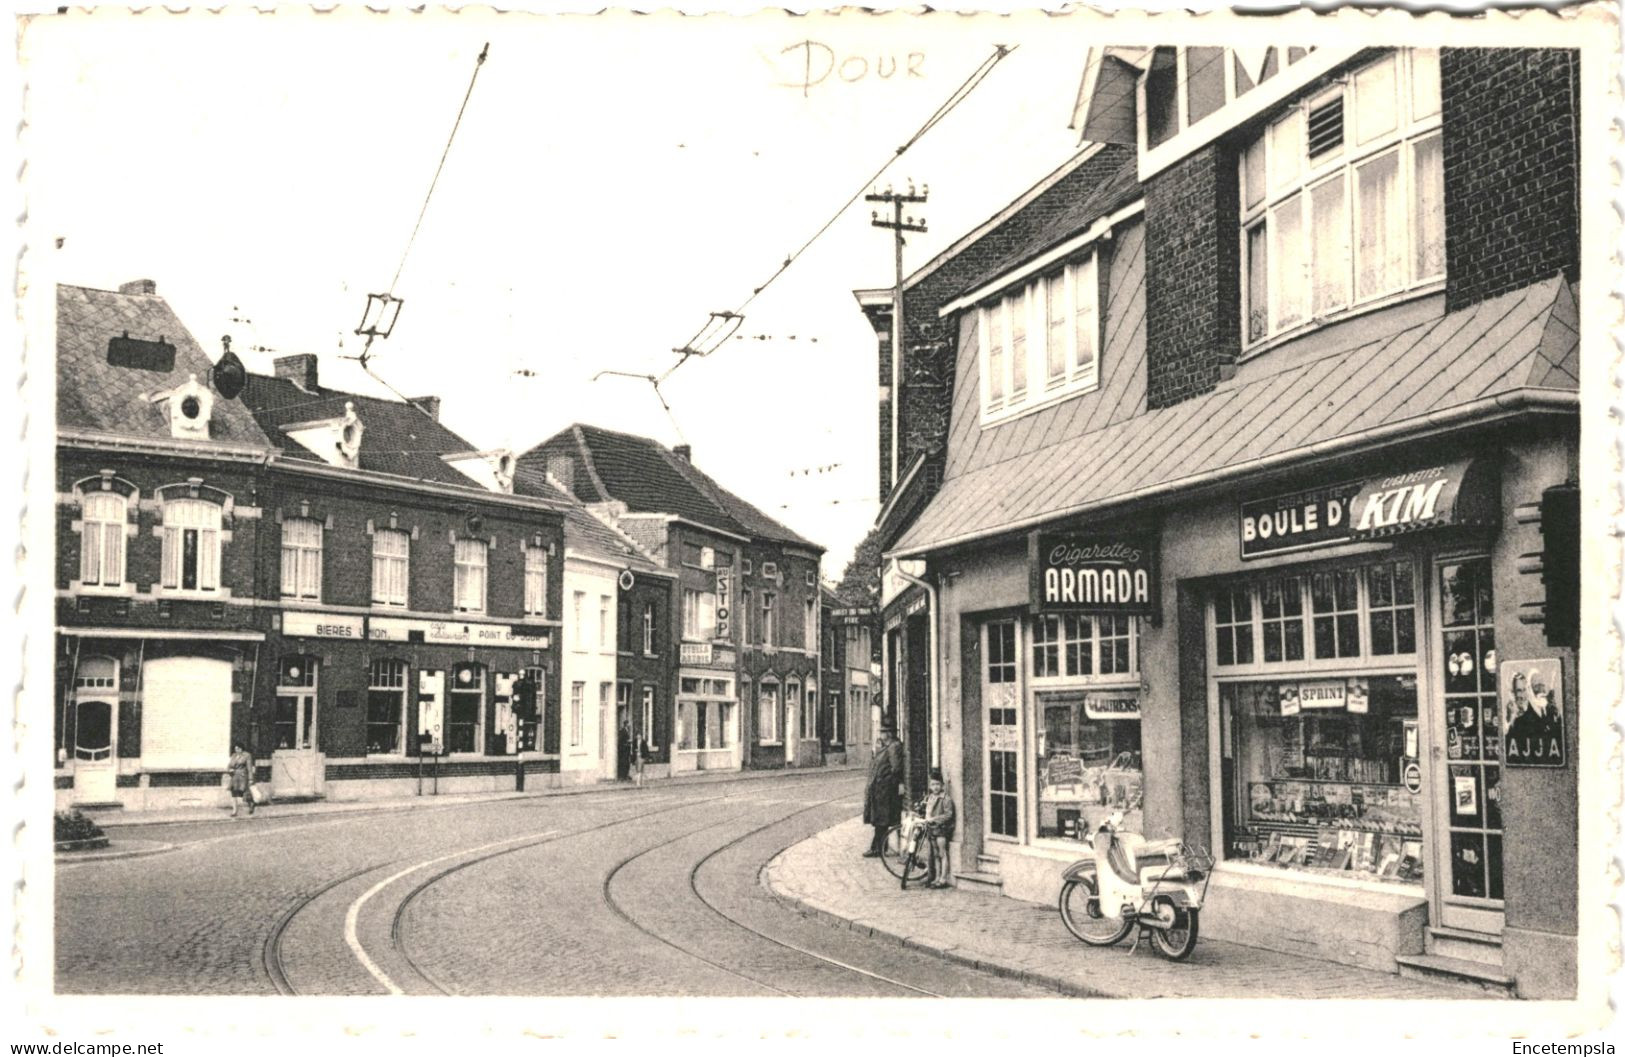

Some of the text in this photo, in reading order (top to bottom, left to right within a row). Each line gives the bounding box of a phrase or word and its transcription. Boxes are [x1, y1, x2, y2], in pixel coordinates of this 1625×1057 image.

[778, 40, 924, 97] DOUR
[1381, 466, 1444, 488] CIGARETTES
[1356, 478, 1448, 531] KIM
[1243, 504, 1318, 542] BOULE
[1050, 543, 1142, 565] Cigarettes
[1045, 567, 1148, 603] ARMADA
[717, 578, 729, 636] STOP
[316, 624, 352, 637] BIERES
[479, 630, 501, 640] POINT
[1302, 687, 1344, 701] SPRINT
[1508, 737, 1560, 758] AJJA
